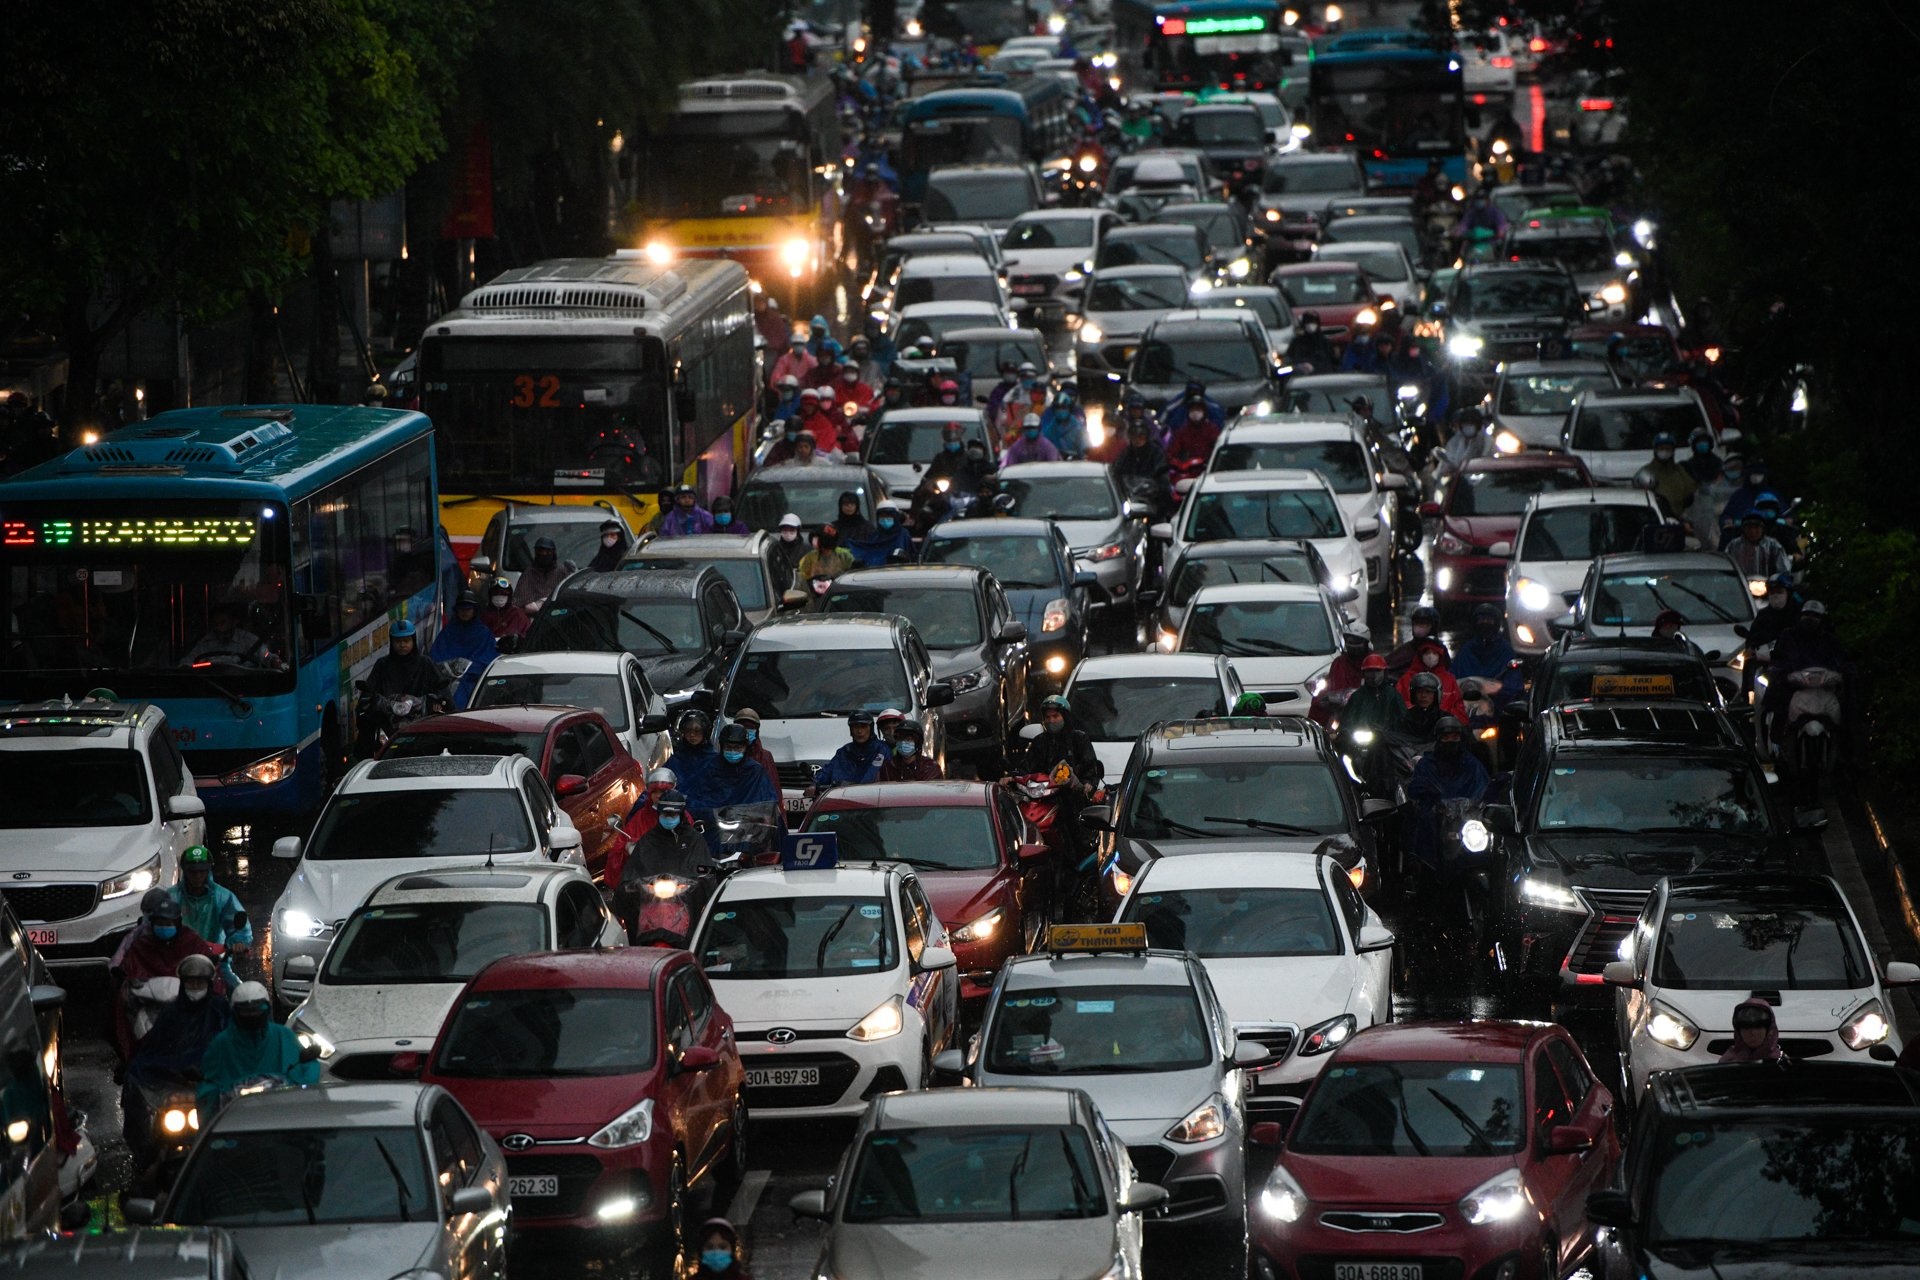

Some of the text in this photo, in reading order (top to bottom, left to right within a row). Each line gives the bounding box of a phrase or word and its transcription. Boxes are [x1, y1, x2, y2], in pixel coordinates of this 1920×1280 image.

[514, 374, 561, 409] 32
[1619, 685, 1649, 693] THANH
[795, 838, 824, 867] G7
[746, 1069, 818, 1085] 30A-897.98
[510, 1179, 556, 1195] 262.39
[1337, 1265, 1420, 1280] 30A-68890
